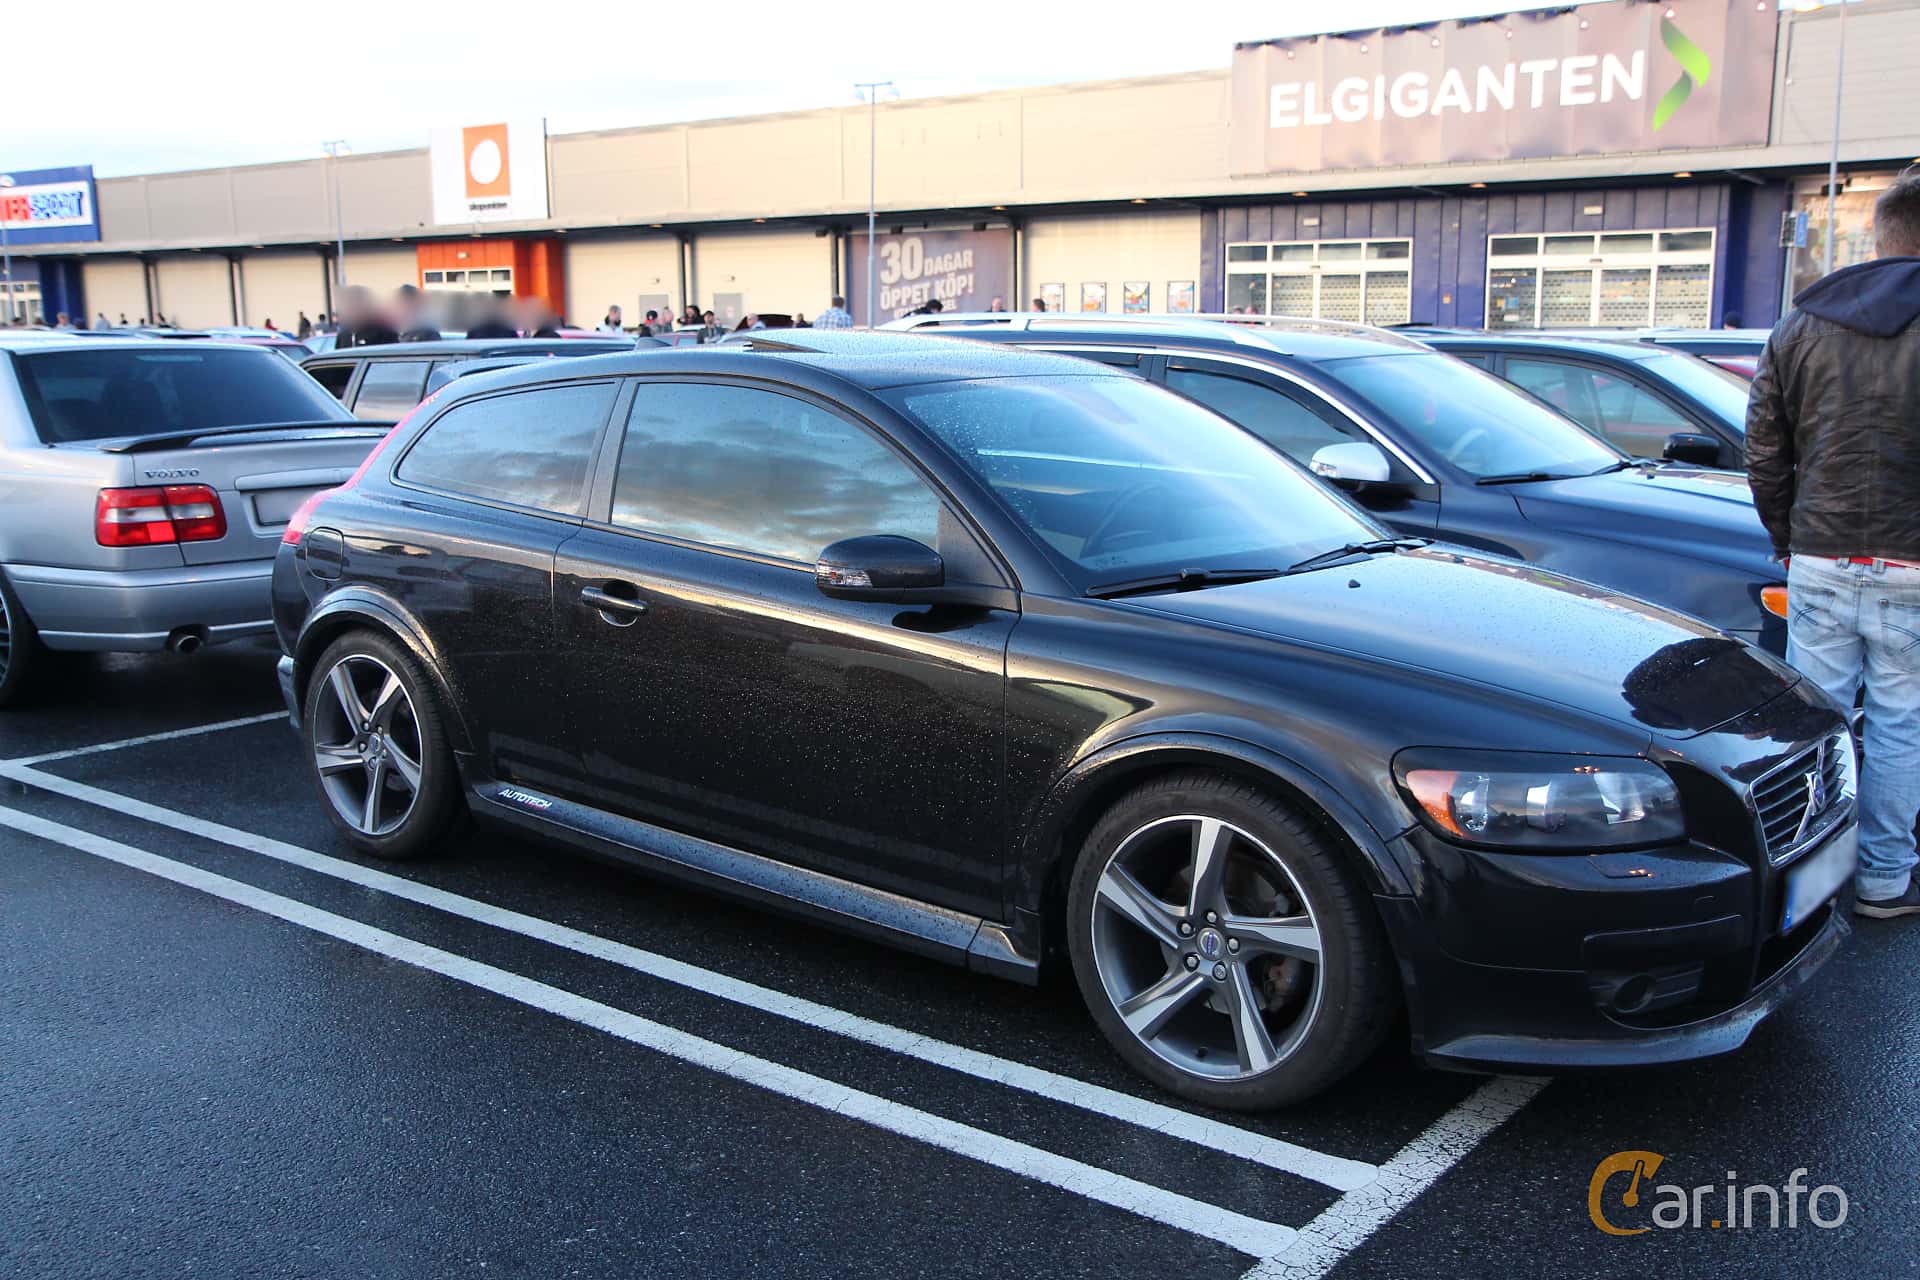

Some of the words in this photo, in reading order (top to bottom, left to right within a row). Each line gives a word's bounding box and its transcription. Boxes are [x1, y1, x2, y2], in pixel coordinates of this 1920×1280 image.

[1270, 50, 1645, 129] ELGIGANTEN
[880, 237, 923, 284] 30
[923, 248, 973, 276] DAGAR
[881, 283, 930, 311] ÖPPET
[935, 273, 974, 299] KÖP!
[144, 468, 200, 479] VOLVO
[498, 788, 553, 808] AUTOTECH
